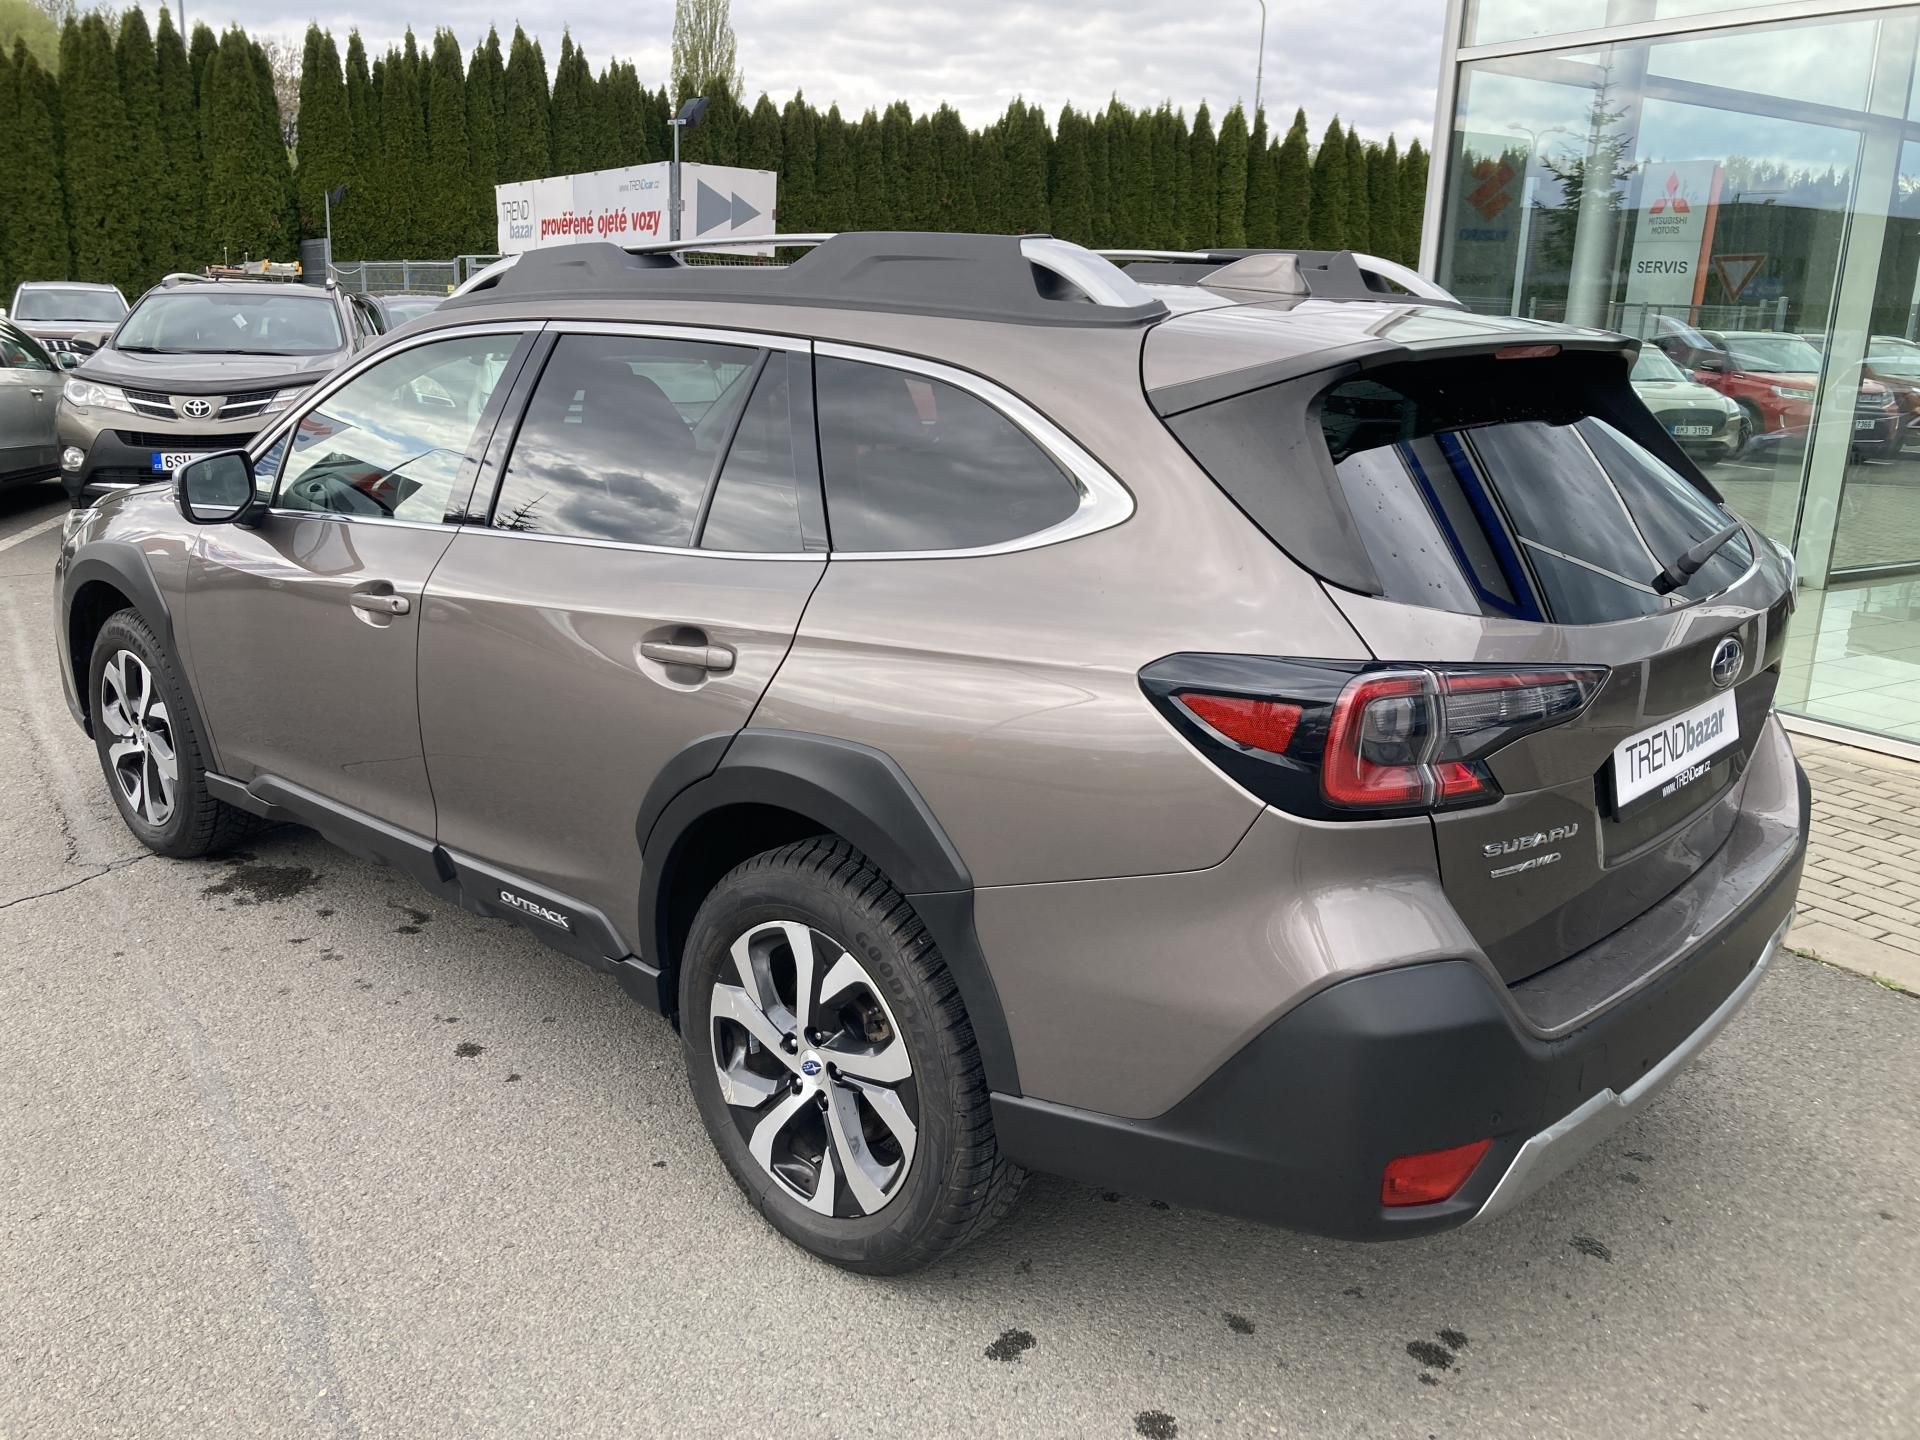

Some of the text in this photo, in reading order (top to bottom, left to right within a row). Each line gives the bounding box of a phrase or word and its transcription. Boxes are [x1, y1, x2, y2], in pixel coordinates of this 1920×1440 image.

[501, 199, 530, 221] TREND
[1648, 216, 1688, 225] MITSUBISHI
[509, 223, 533, 239] bazar
[540, 207, 662, 240] prověřené ojeté vozy
[1650, 226, 1680, 235] MOTORS
[1636, 260, 1689, 274] SERVIS
[1625, 707, 1725, 783] TRENDbazar
[1483, 822, 1579, 858] SUBARU
[499, 890, 569, 928] OUTBACK
